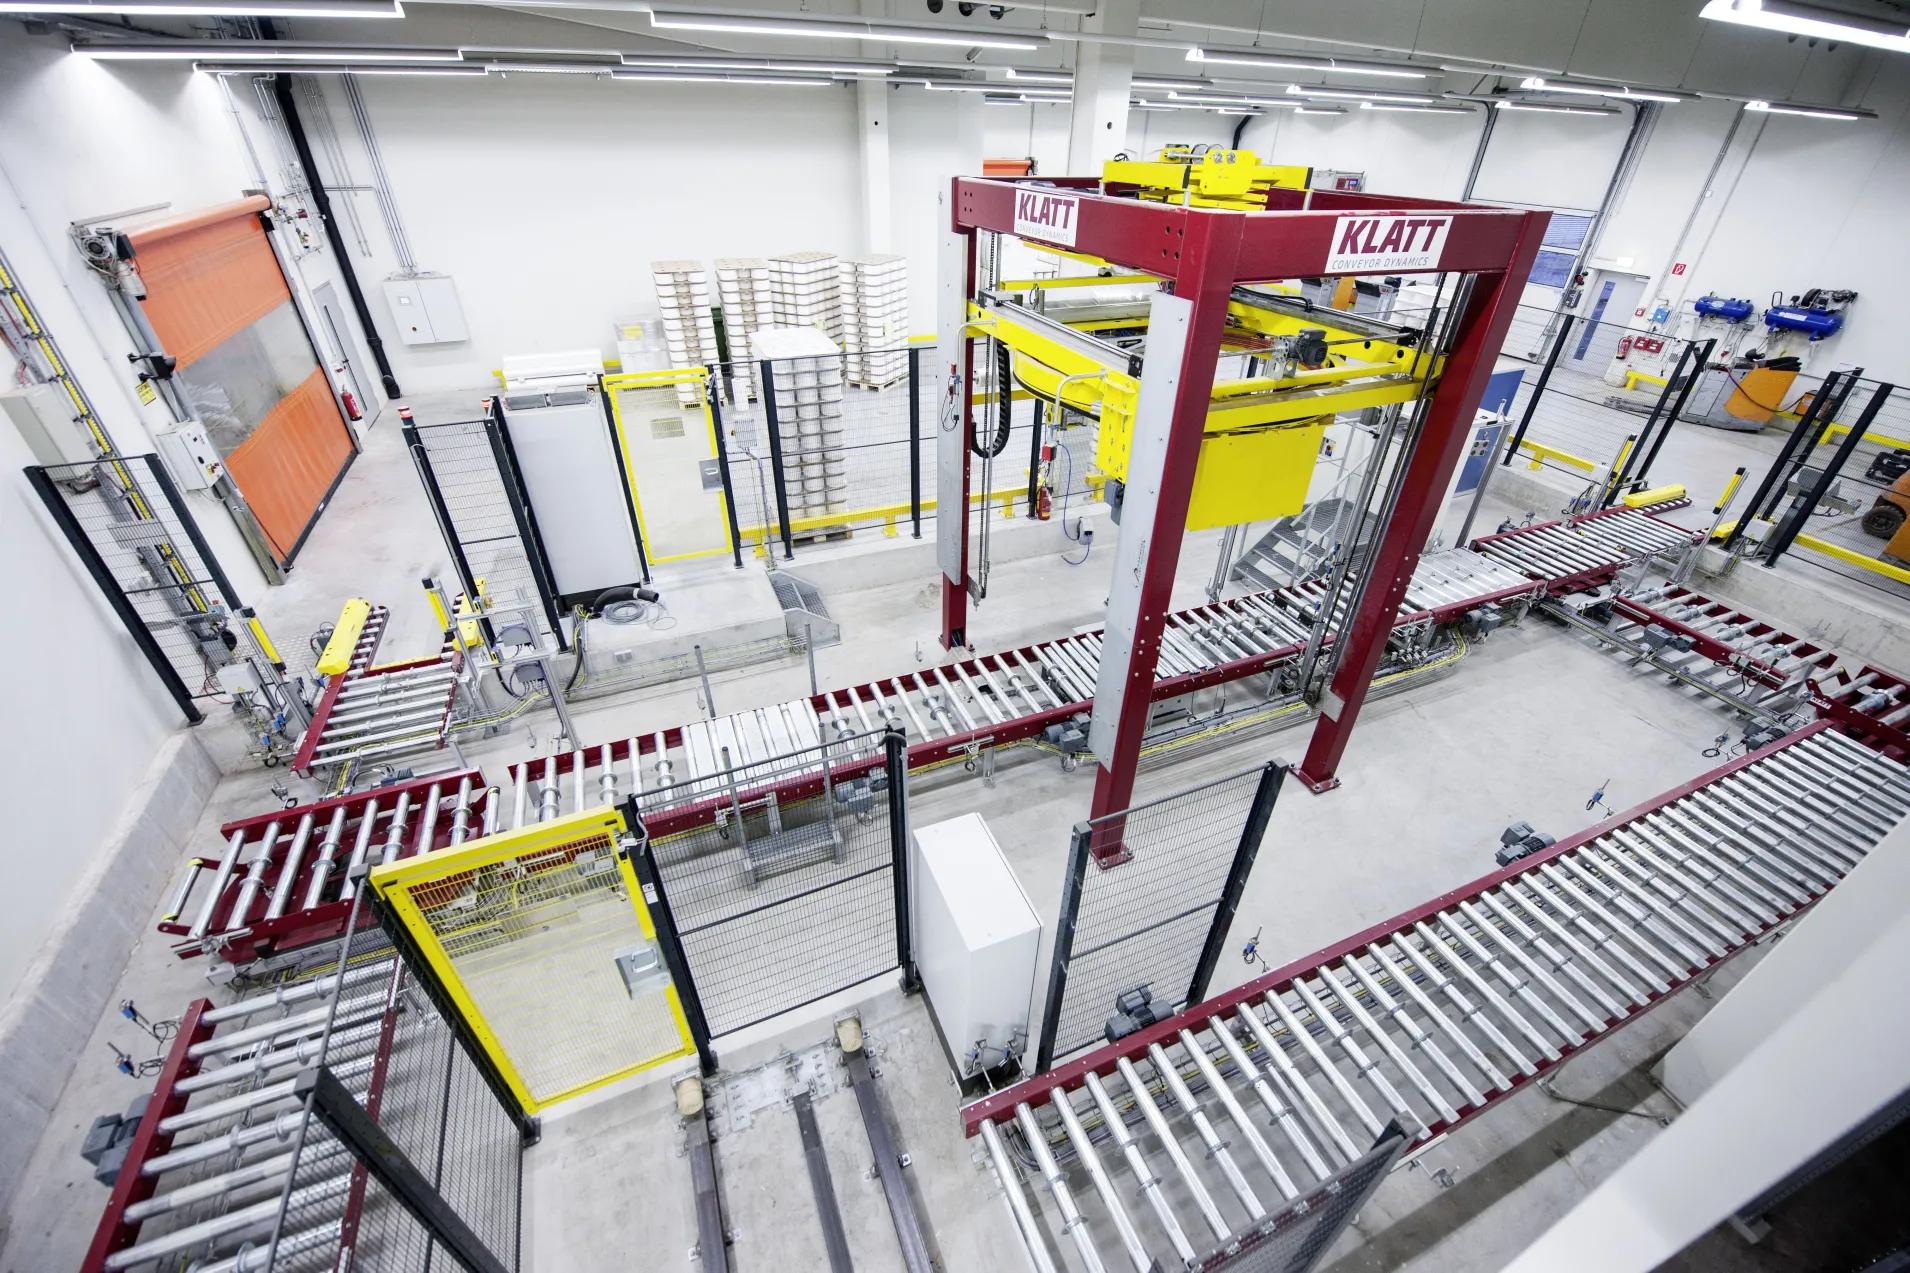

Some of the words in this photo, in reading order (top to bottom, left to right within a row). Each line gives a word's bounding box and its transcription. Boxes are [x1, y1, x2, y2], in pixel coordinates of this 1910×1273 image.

[1018, 193, 1075, 229] KLATT
[1337, 219, 1447, 254] KLATT
[1332, 259, 1380, 270] CONVEYOR
[1384, 257, 1429, 267] DYNAMICS
